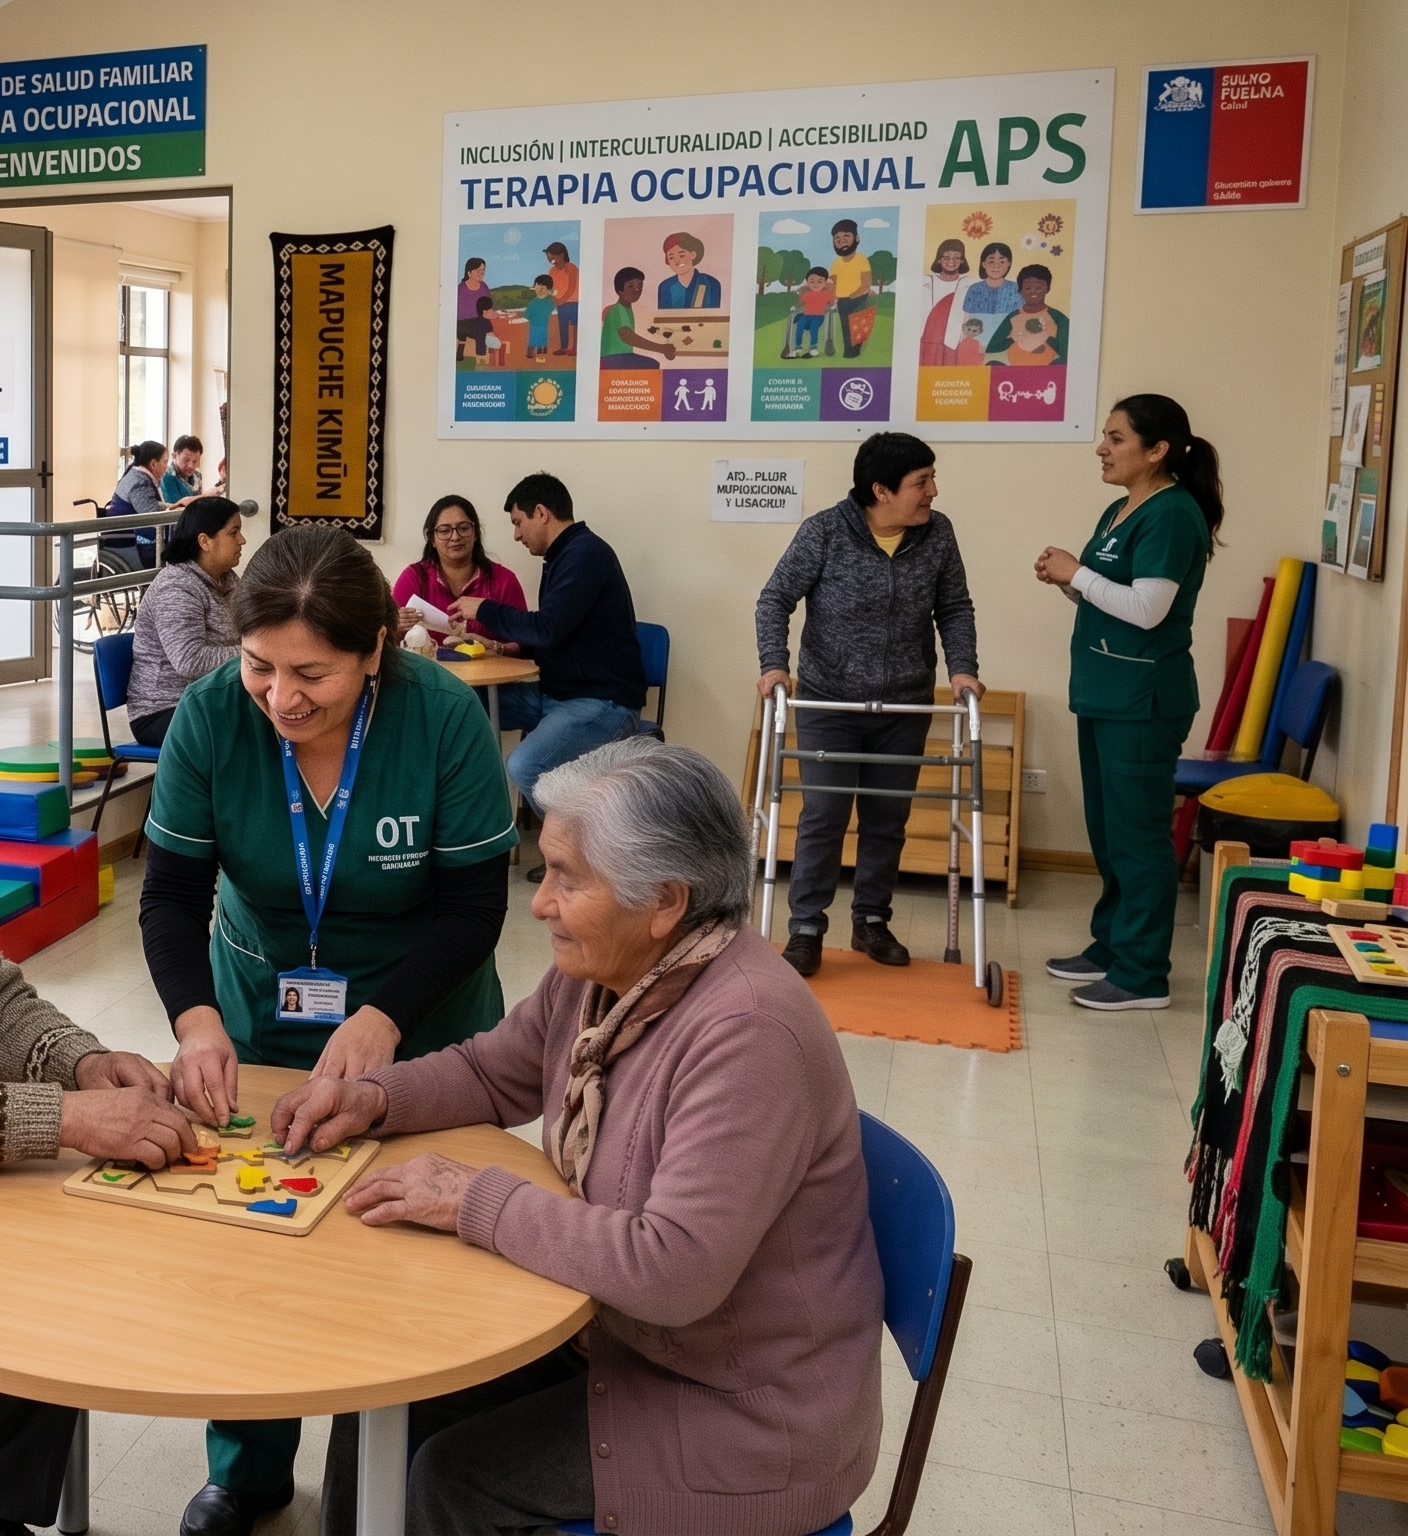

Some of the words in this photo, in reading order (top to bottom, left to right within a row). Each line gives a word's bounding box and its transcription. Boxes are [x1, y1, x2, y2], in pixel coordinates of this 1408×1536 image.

[1, 75, 27, 97] DE
[31, 69, 94, 95] SALUD
[100, 60, 194, 89] FAMILIAR
[23, 96, 196, 132] OCUPACIONAL
[460, 139, 555, 165] INCLUSIÓN
[569, 130, 763, 160] INTERCULTURALIDAD
[778, 120, 928, 148] ACCESIBILIDAD
[460, 171, 618, 211] TERAPIA
[630, 156, 926, 203] OCUPACIONAL
[938, 112, 1088, 189] APS
[316, 263, 346, 399] MAPUCHE
[375, 815, 420, 848] OT
